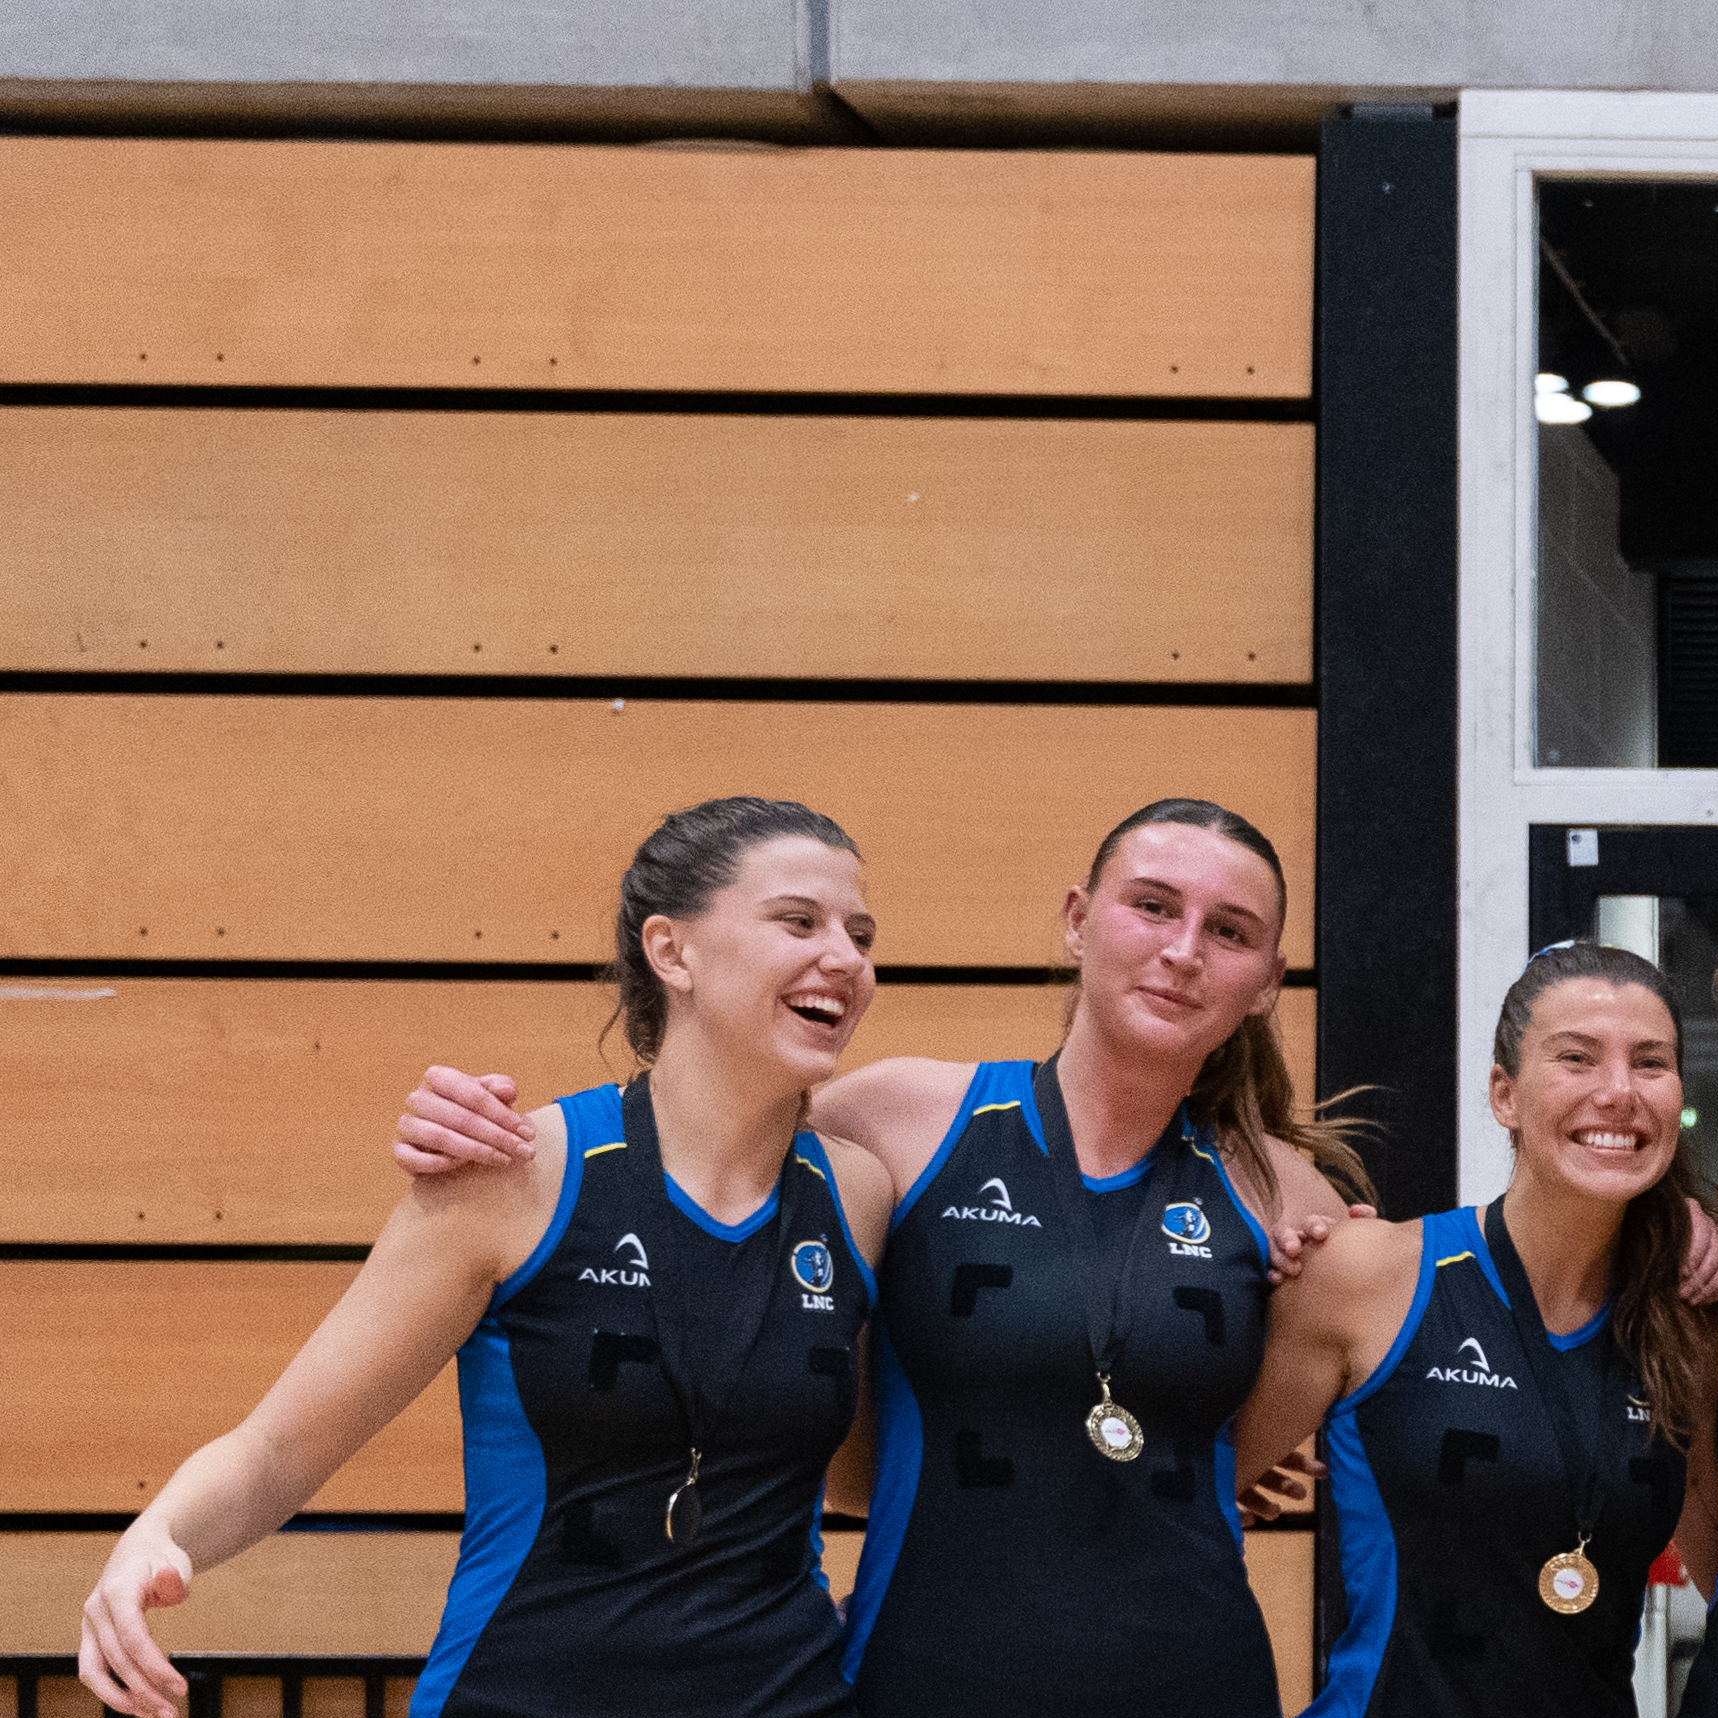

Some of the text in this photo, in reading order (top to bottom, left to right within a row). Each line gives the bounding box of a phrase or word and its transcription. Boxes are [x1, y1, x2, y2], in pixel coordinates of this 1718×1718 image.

[941, 1206, 1043, 1228] AKUMA
[1168, 1242, 1212, 1258] LNC
[802, 1294, 834, 1311] LNC
[1427, 1366, 1518, 1389] AKUMA
[1627, 1406, 1651, 1421] LN
